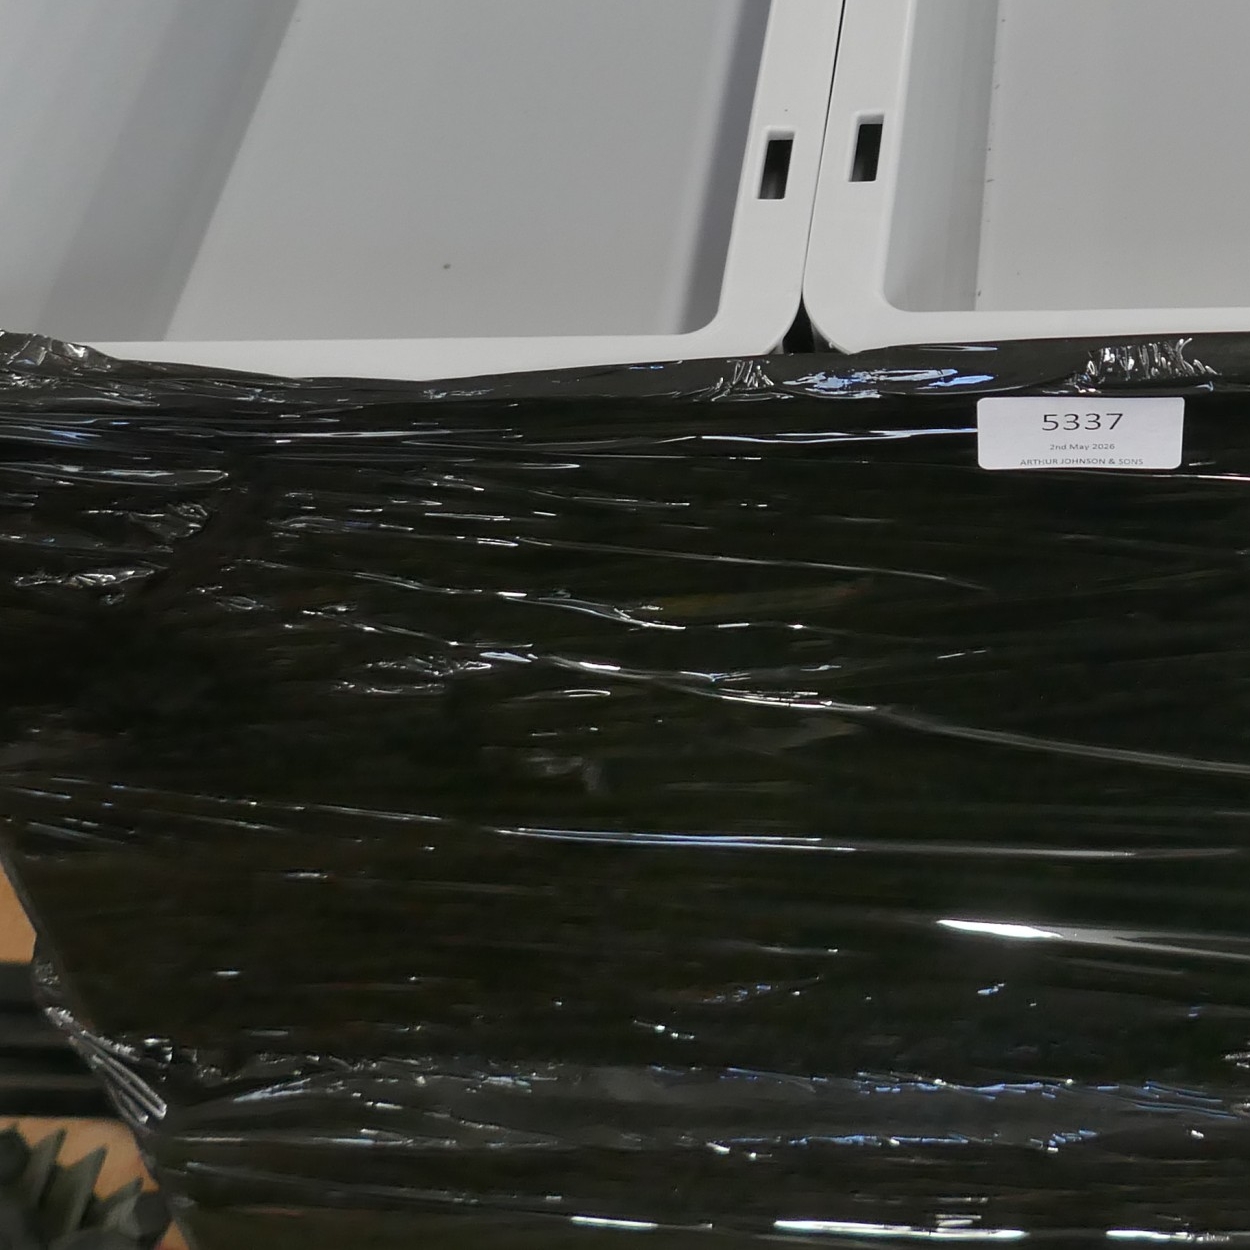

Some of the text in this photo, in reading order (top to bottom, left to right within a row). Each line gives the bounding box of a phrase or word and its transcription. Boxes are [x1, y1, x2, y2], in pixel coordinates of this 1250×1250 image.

[1042, 413, 1124, 432] 5337
[1050, 443, 1067, 451] 2nd
[1069, 443, 1090, 452] May
[1020, 457, 1144, 466] ARTHUR JOHNSON & SONS
